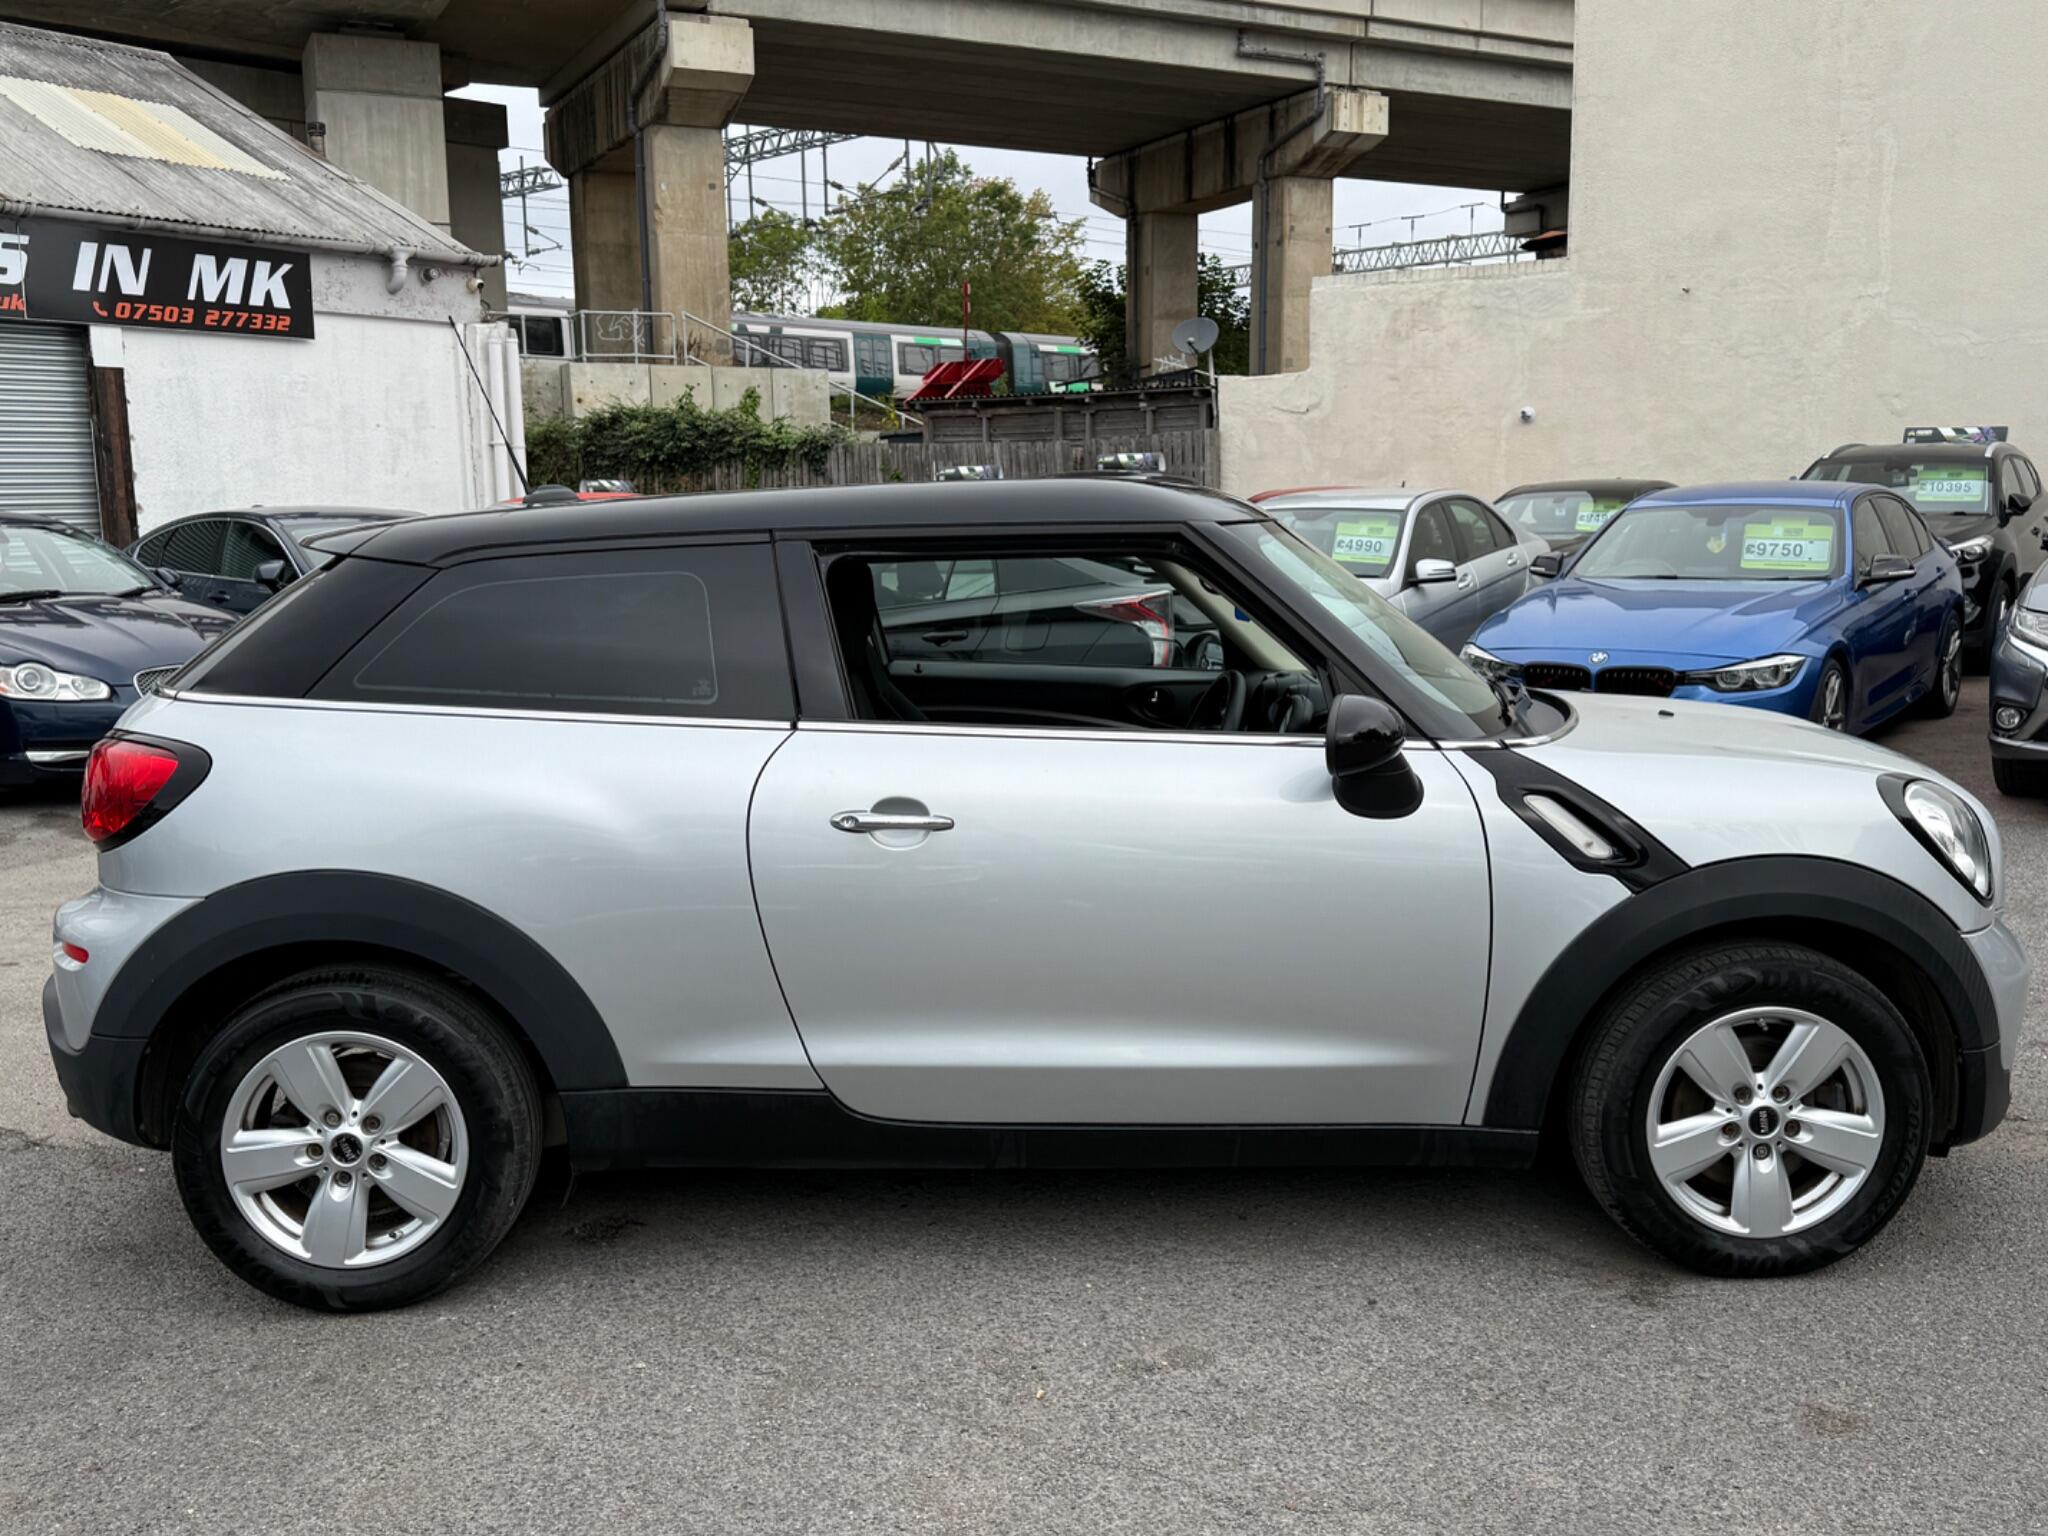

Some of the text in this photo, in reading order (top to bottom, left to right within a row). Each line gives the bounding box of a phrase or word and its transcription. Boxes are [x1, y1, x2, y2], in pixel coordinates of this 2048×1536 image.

[72, 241, 152, 296] IN
[187, 253, 294, 309] MK
[115, 302, 292, 332] 07503 277332
[1337, 539, 1383, 553] £4990
[1745, 542, 1803, 557] £9750
